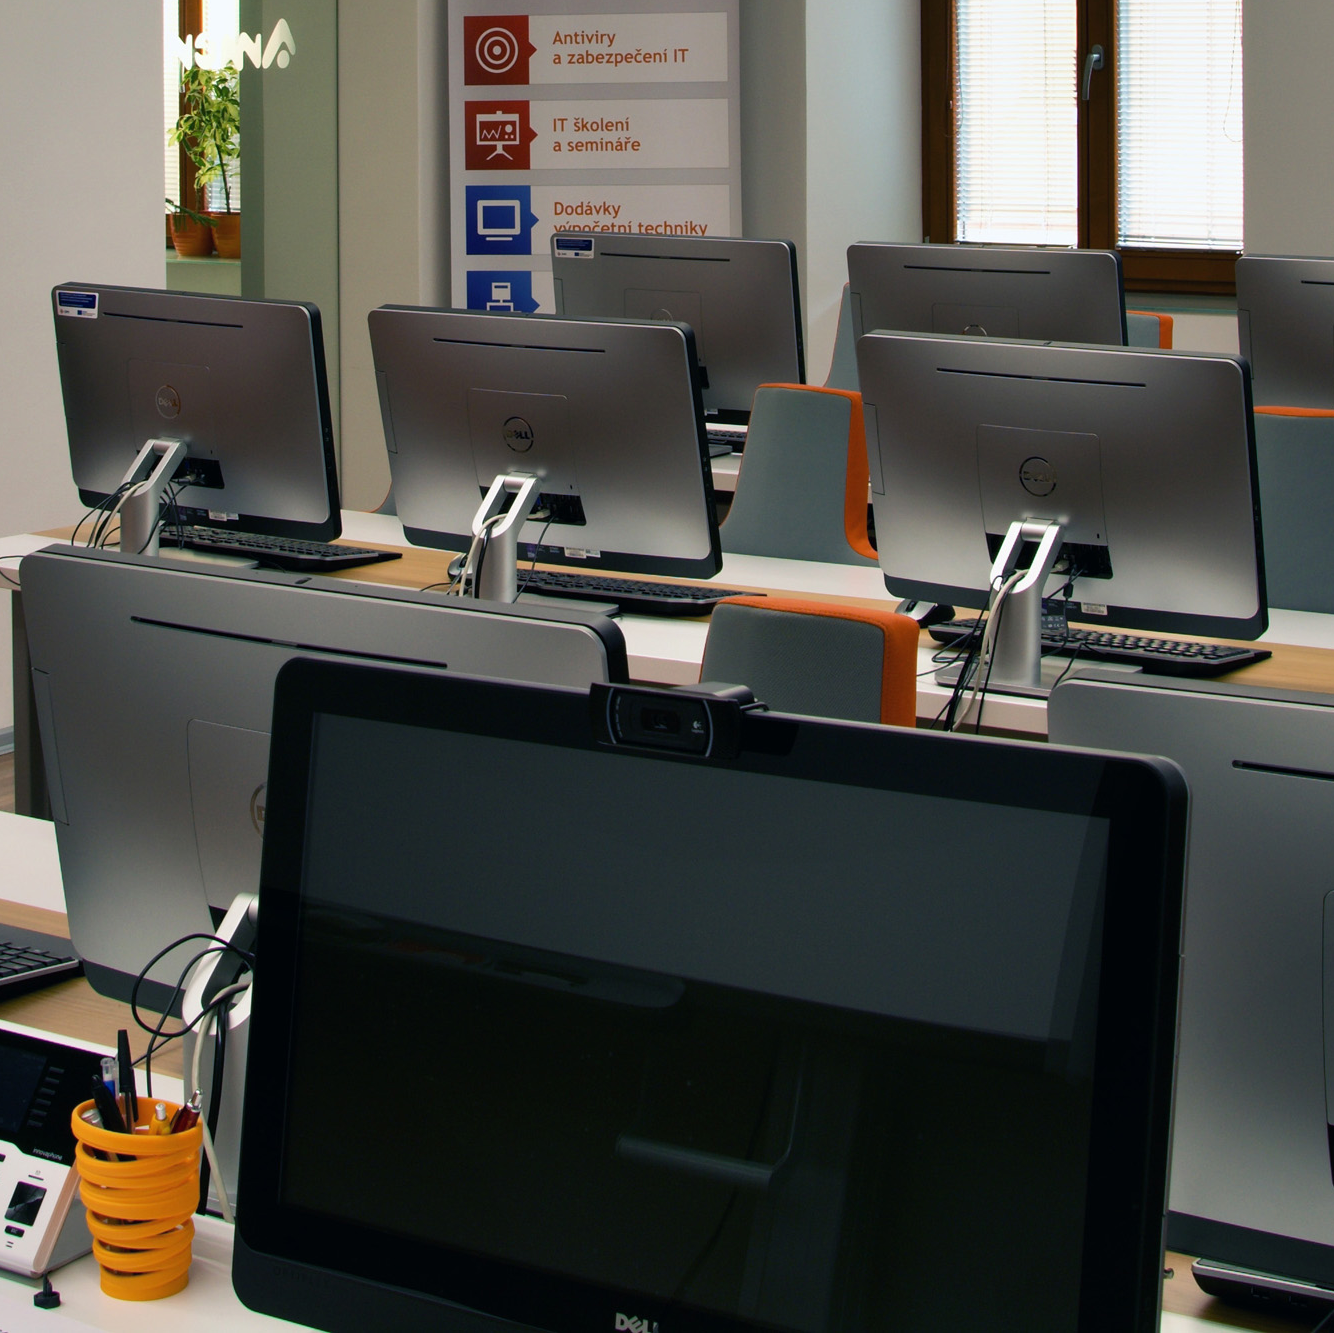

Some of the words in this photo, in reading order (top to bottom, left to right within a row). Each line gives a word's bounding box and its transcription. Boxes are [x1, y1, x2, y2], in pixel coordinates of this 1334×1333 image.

[552, 30, 616, 48] Antiviry
[552, 53, 562, 65] a
[567, 48, 668, 67] zabezpečení
[673, 48, 689, 63] IT
[553, 118, 568, 132] IT
[573, 117, 630, 133] školení
[553, 141, 562, 153] a
[567, 136, 641, 152] semináře
[554, 201, 621, 219] Dodávky
[638, 220, 708, 237] techniky
